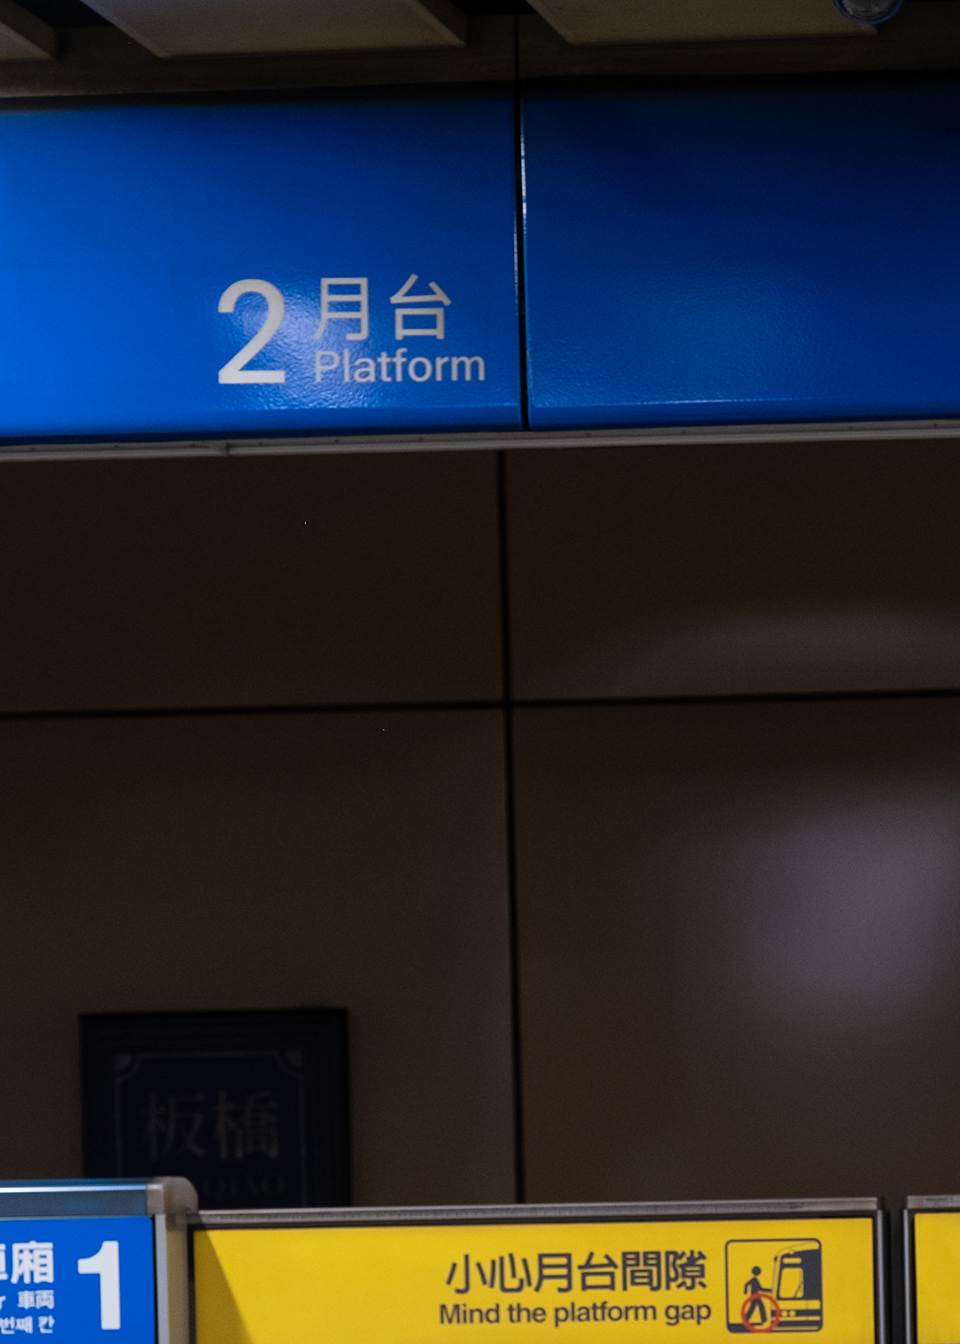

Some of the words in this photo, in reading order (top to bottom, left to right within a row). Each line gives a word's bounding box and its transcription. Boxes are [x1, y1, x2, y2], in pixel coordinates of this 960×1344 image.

[217, 278, 286, 384] 2
[314, 274, 452, 341] 月台
[314, 347, 486, 383] Platform
[141, 1090, 280, 1162] 板橋
[0, 1240, 54, 1284] 廂
[77, 1240, 121, 1330] 1
[446, 1250, 708, 1294] 小心月台間隙
[38, 1315, 55, 1334] 칸
[439, 1303, 500, 1325] Mind
[507, 1303, 547, 1324] the
[554, 1301, 657, 1328] platform
[664, 1303, 712, 1327] gap
